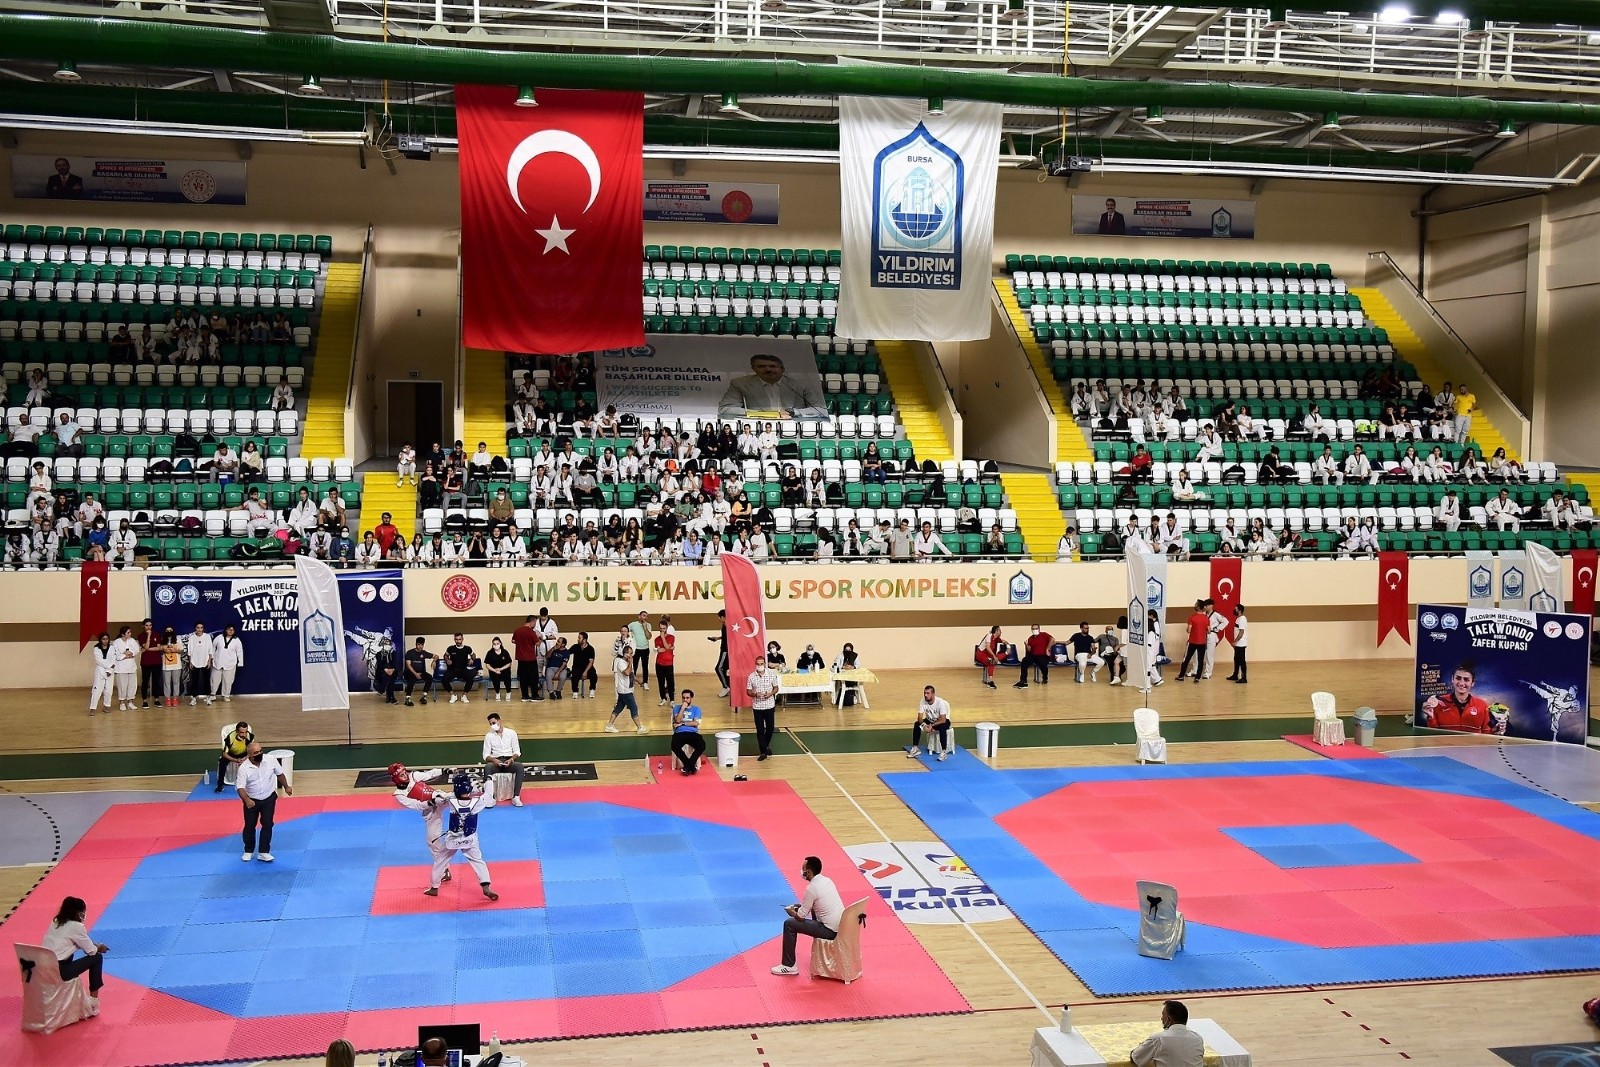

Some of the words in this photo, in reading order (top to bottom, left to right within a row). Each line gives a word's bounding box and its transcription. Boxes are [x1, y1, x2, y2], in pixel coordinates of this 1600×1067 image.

[907, 155, 933, 163] BURSA
[879, 255, 954, 272] YILDIRIM
[877, 273, 954, 286] BELEDİYESİ
[605, 373, 671, 381] BAŞARILAR
[237, 583, 273, 596] YILDIRIM
[489, 577, 559, 602] NAİM
[789, 579, 852, 600] SPOR
[860, 573, 997, 599] KOMPLEKSİ
[242, 619, 274, 631] ZAFER
[1497, 614, 1533, 625] BELEDİYESİ
[1466, 623, 1534, 642] TAEKWONDO
[1472, 638, 1496, 649] ZAFER
[1498, 640, 1528, 651] KUPASI
